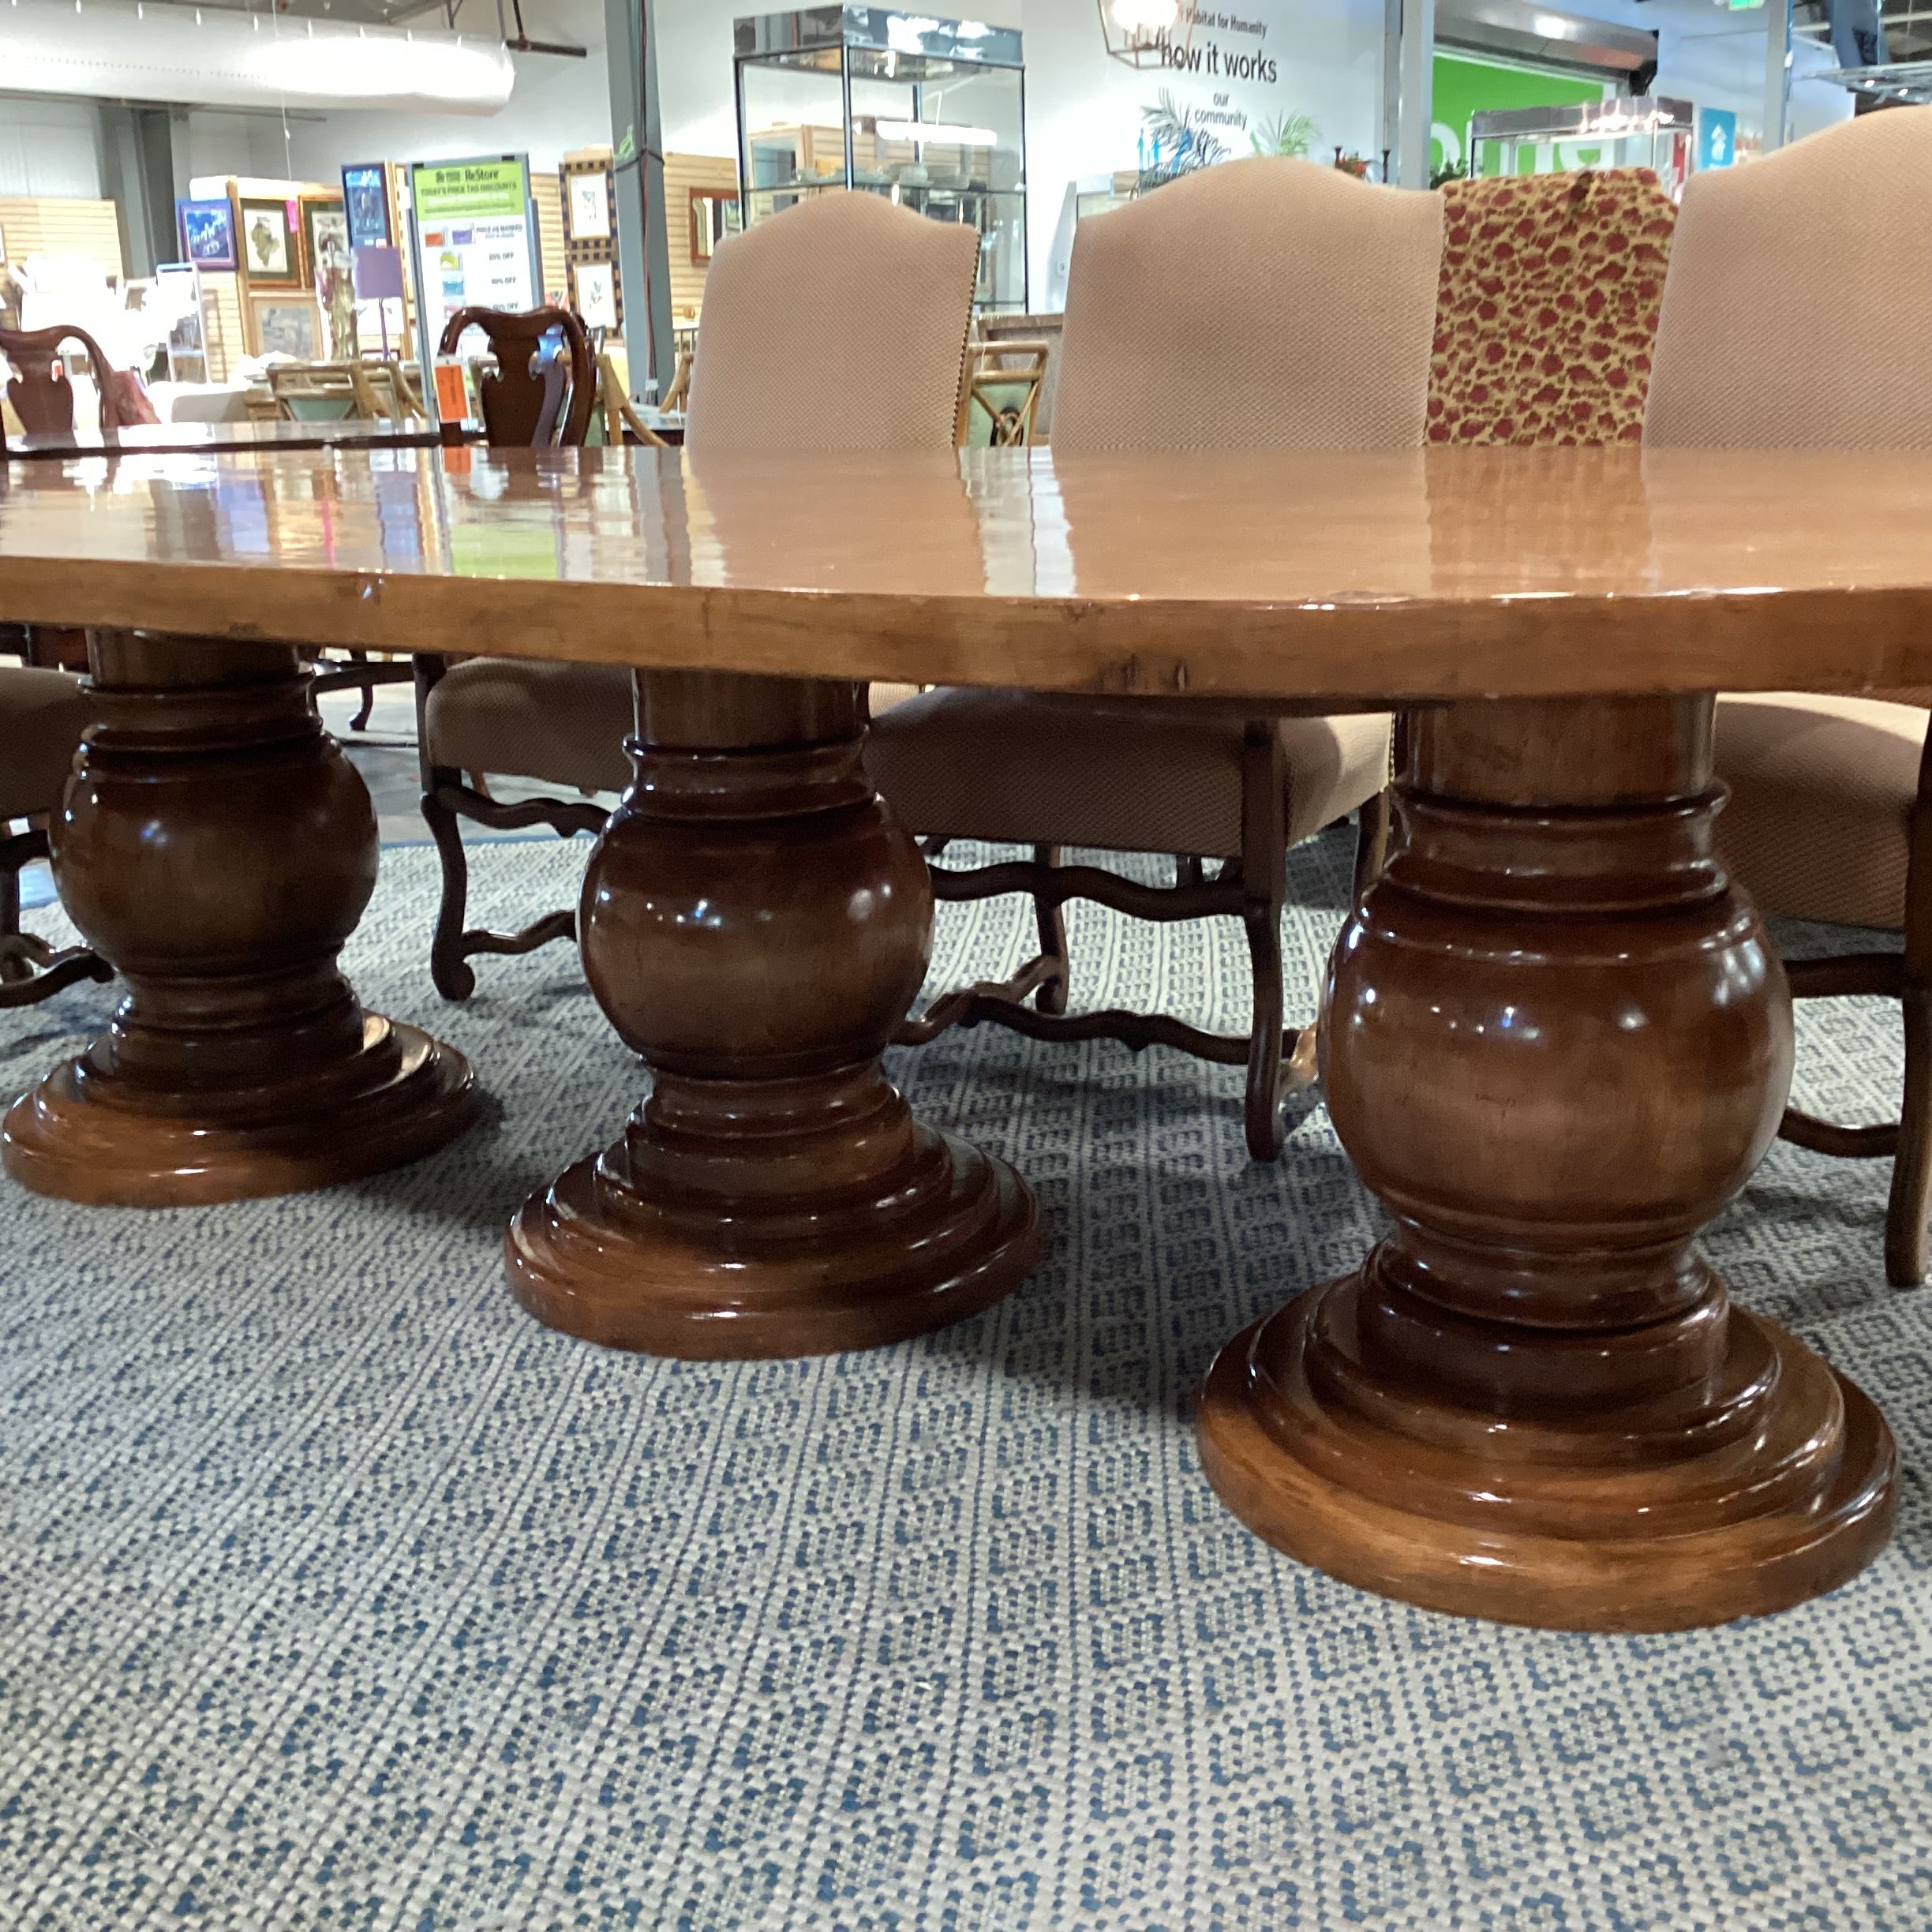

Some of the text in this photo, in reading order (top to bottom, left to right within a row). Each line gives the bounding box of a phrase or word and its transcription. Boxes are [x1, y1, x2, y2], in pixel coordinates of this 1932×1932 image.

[1186, 7, 1215, 28] Habitat
[1218, 13, 1230, 29] for
[1230, 13, 1269, 40] Humanity
[1161, 35, 1278, 84] how it works
[1213, 92, 1230, 107] our
[1194, 108, 1248, 131] community
[464, 168, 499, 182] ReStore
